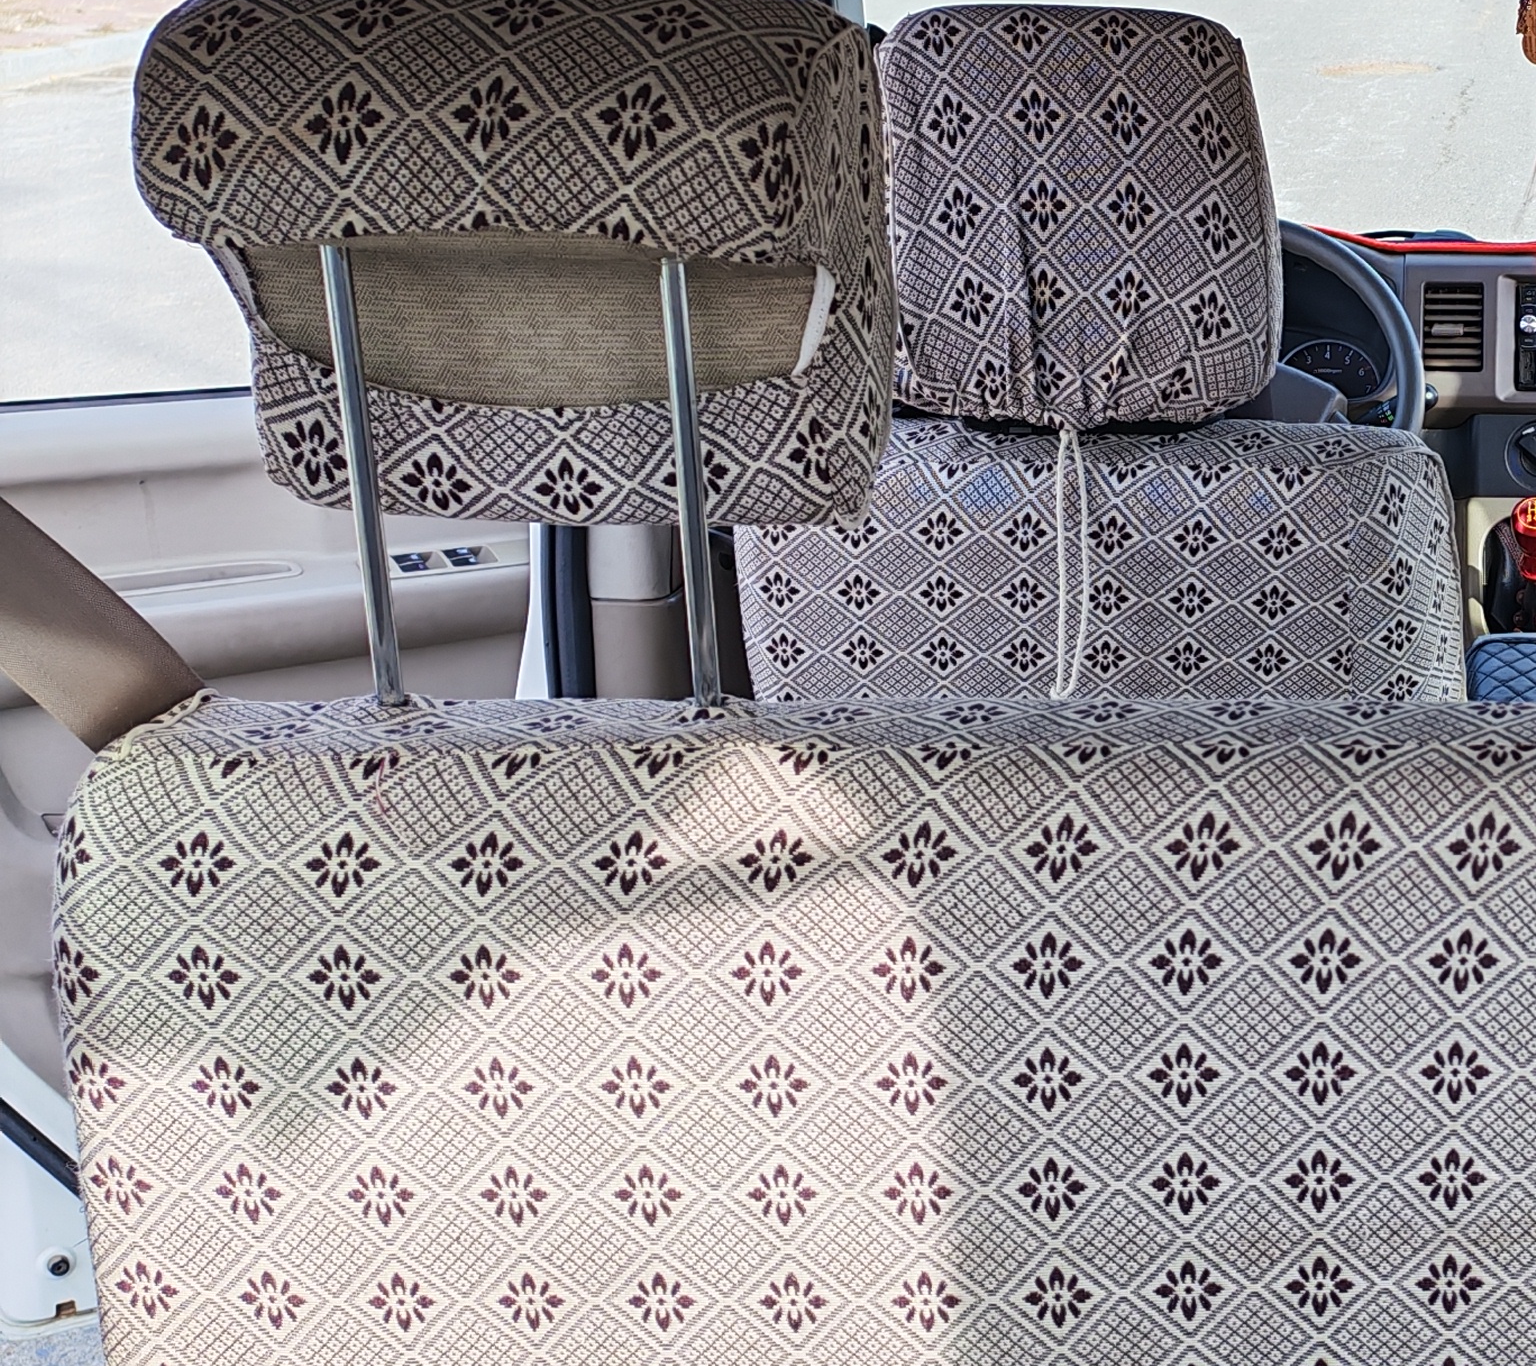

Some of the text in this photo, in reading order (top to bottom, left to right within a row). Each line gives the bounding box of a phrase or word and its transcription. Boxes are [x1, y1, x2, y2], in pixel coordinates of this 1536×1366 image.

[1306, 351, 1372, 393] 3 4 5 6 7
